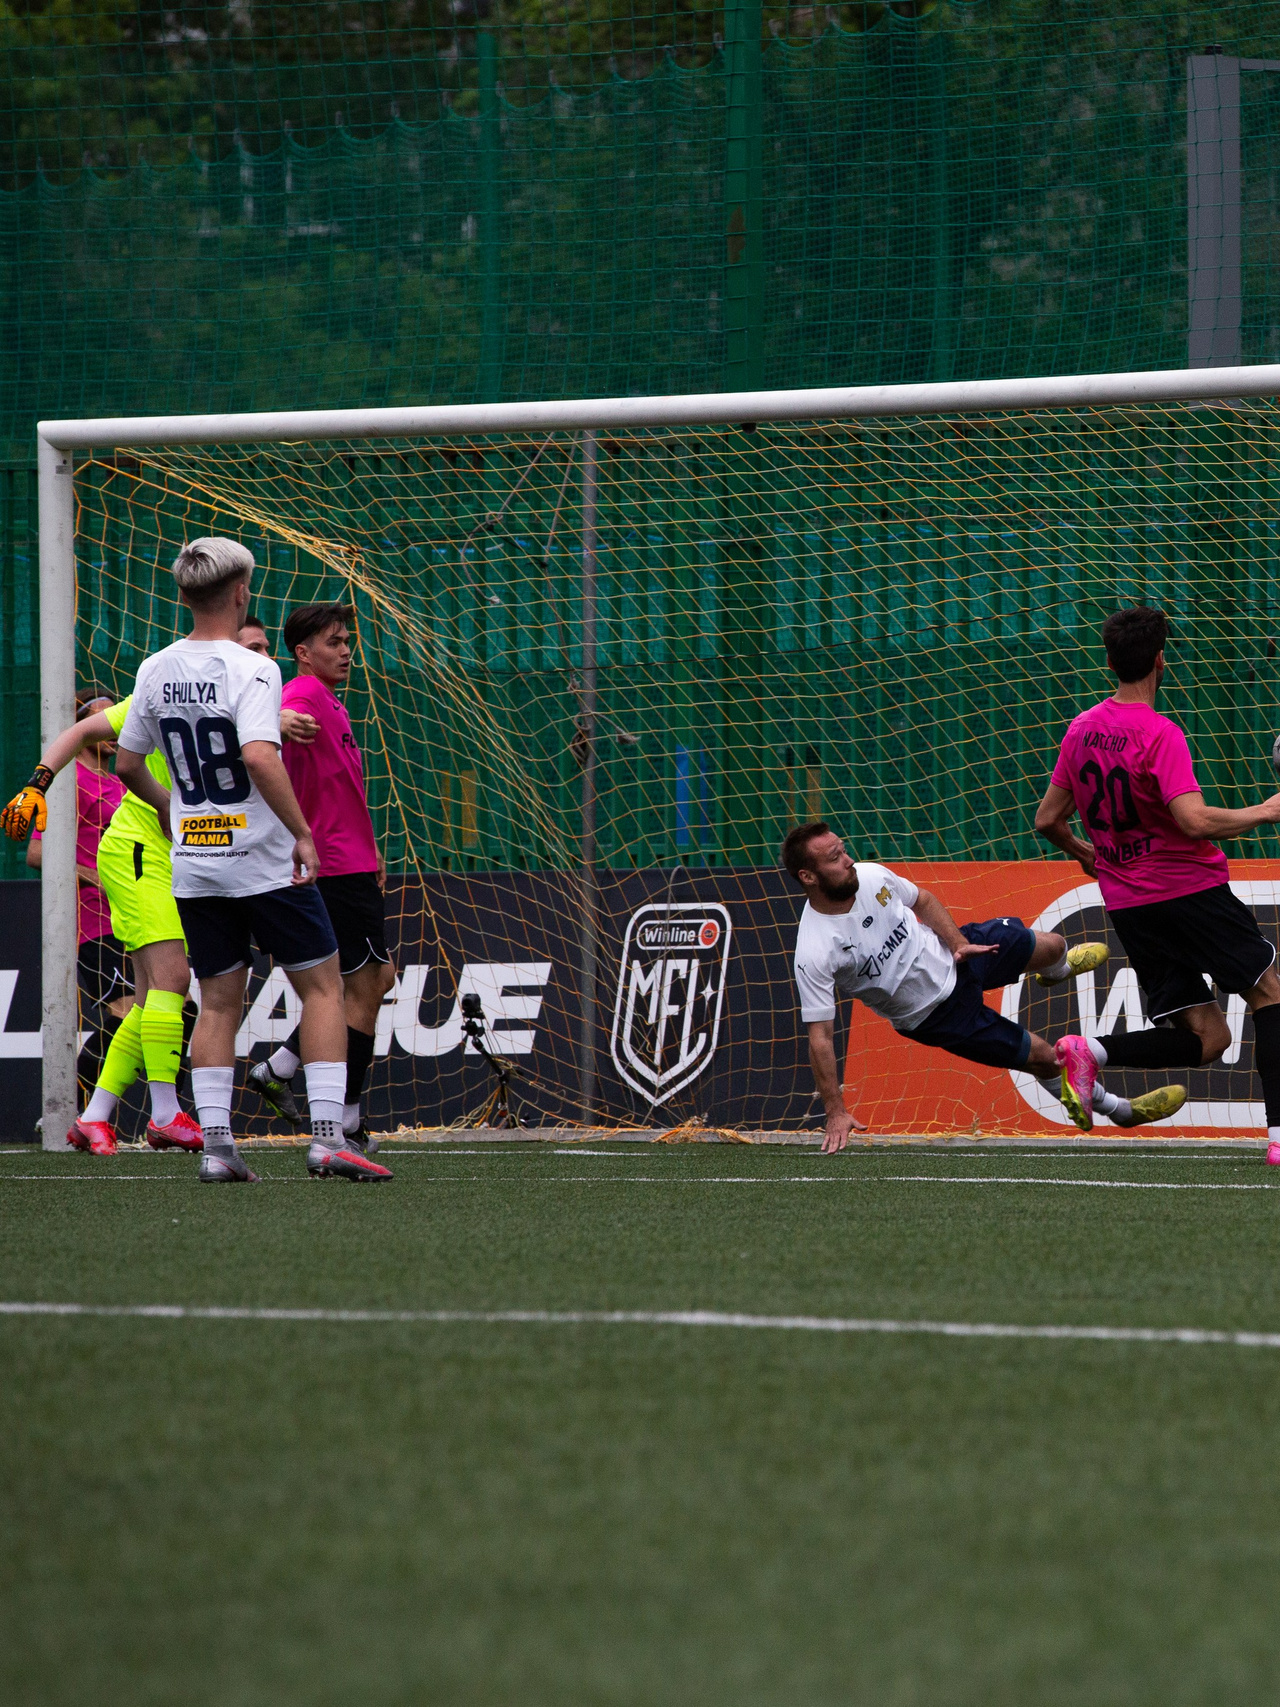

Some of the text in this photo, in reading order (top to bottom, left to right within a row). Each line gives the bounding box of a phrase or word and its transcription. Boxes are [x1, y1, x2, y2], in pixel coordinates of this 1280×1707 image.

[163, 682, 217, 704] SHULYA
[159, 716, 251, 806] 08
[1079, 759, 1142, 833] 20
[182, 816, 241, 831] FOOTBALL
[186, 833, 230, 845] MANIA
[644, 927, 696, 943] Winline
[877, 917, 909, 966] FCMAT
[622, 958, 707, 1088] MFL
